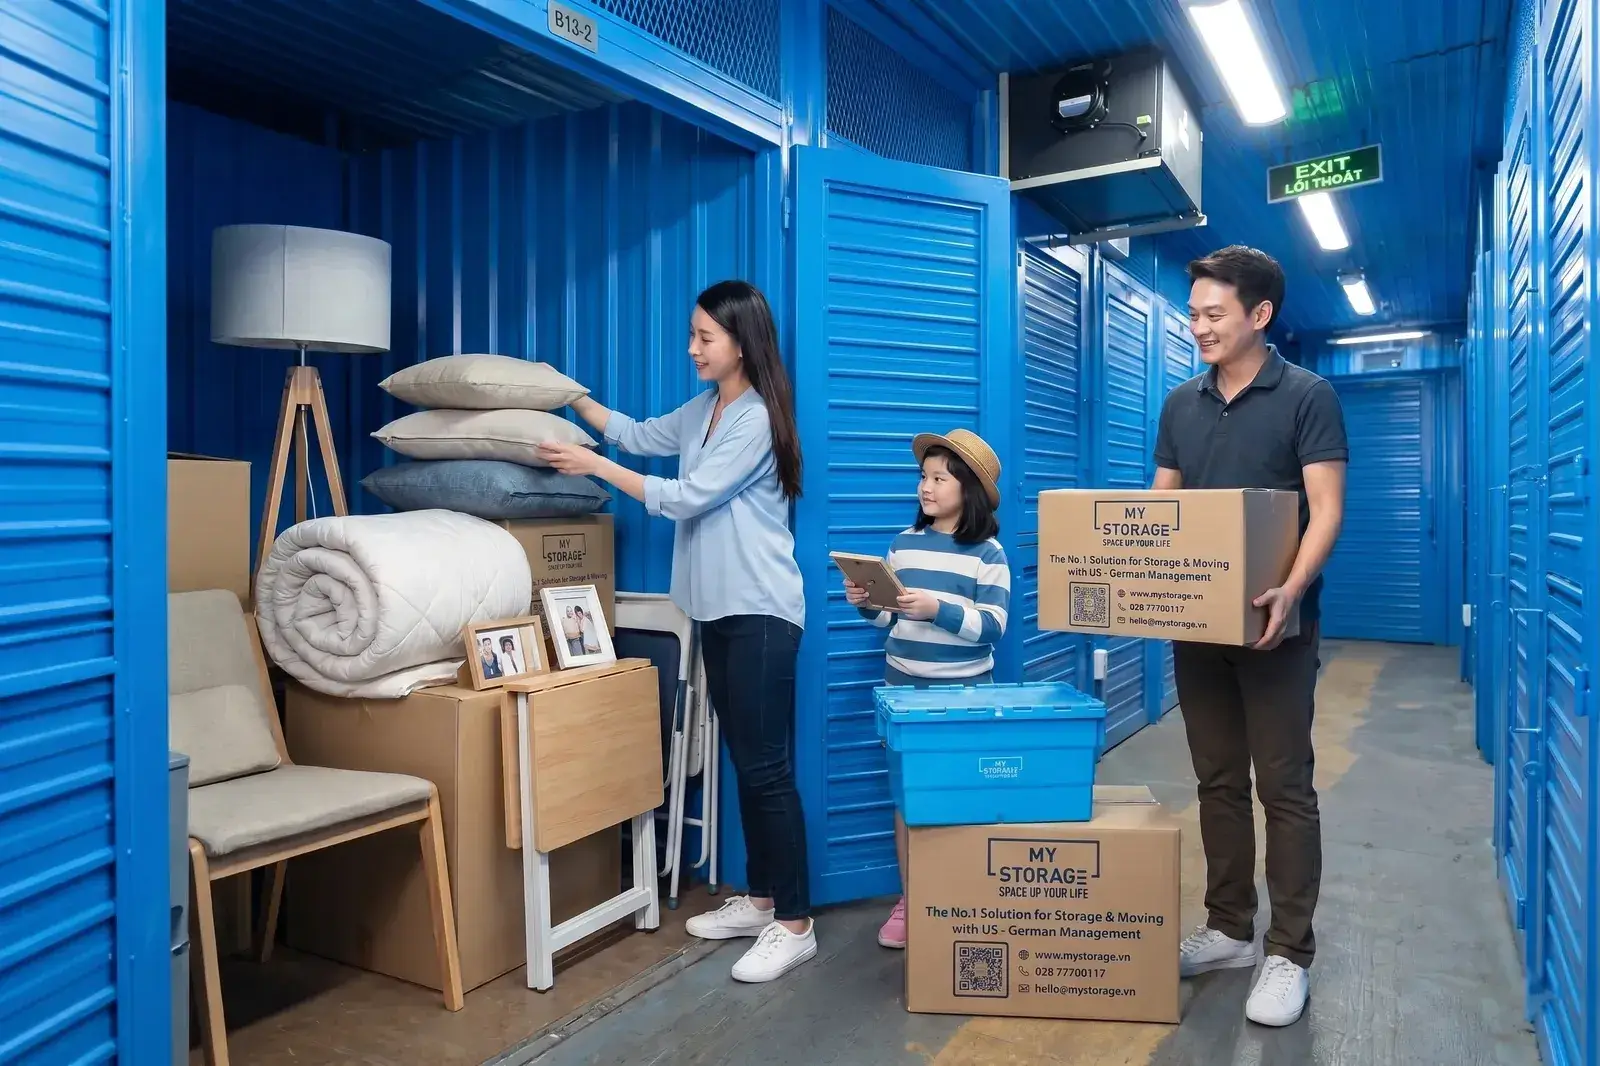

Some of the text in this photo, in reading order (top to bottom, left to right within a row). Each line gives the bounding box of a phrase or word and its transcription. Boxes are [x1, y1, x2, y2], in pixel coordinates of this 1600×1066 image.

[555, 9, 592, 43] B13-2
[1295, 156, 1351, 179] EXIT
[1312, 169, 1363, 188] THOÁT
[1124, 507, 1146, 520] MY
[1102, 523, 1170, 536] STORAGE
[559, 539, 571, 549] MY
[1102, 538, 1171, 548] SPACE UP YOUR LIFE
[547, 550, 583, 562] STORAGE
[1049, 554, 1066, 564] The
[1089, 555, 1127, 565] Solution
[1129, 556, 1142, 566] for
[1144, 557, 1181, 569] Storage
[1183, 558, 1191, 567] &
[1192, 558, 1230, 571] Moving
[1067, 568, 1087, 577] with
[1089, 568, 1102, 577] US
[1109, 569, 1146, 579] German
[1147, 571, 1212, 583] Management
[1129, 590, 1204, 601] www.mystorage.vn
[1129, 603, 1185, 613] 028 77700117
[1129, 617, 1208, 629] hello@mystorage.vn
[1029, 847, 1057, 863] MY
[999, 866, 1087, 885] STORAGE
[999, 886, 1089, 899] SPACE UP YOUR LIFE
[925, 906, 1164, 927] The No.1 Solution for Storage & Moving
[952, 923, 979, 934] with
[982, 923, 999, 935] US
[1008, 924, 1057, 937] German
[1059, 926, 1141, 941] Management
[1035, 951, 1131, 963] www.mystorage.vn
[1035, 966, 1106, 978] 028 77700117
[1035, 983, 1137, 997] hello@mystorage.vn
